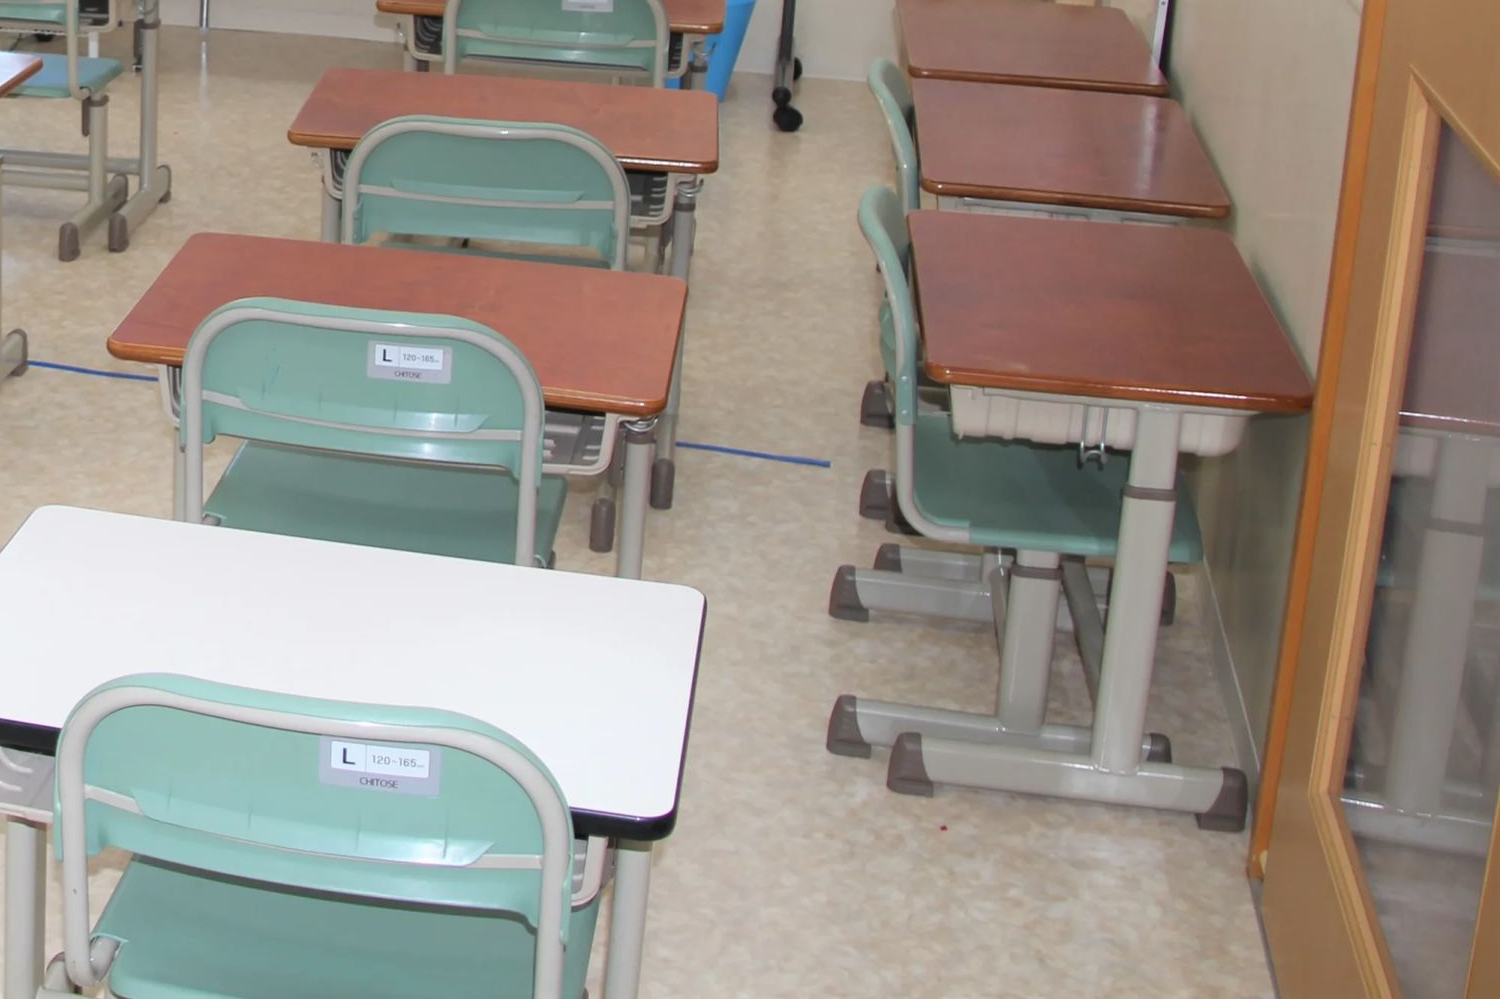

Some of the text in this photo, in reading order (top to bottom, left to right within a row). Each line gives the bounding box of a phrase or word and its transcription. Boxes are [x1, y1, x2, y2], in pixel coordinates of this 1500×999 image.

[382, 348, 393, 362] L
[342, 747, 356, 766] L
[359, 777, 399, 789] CHITOSE
